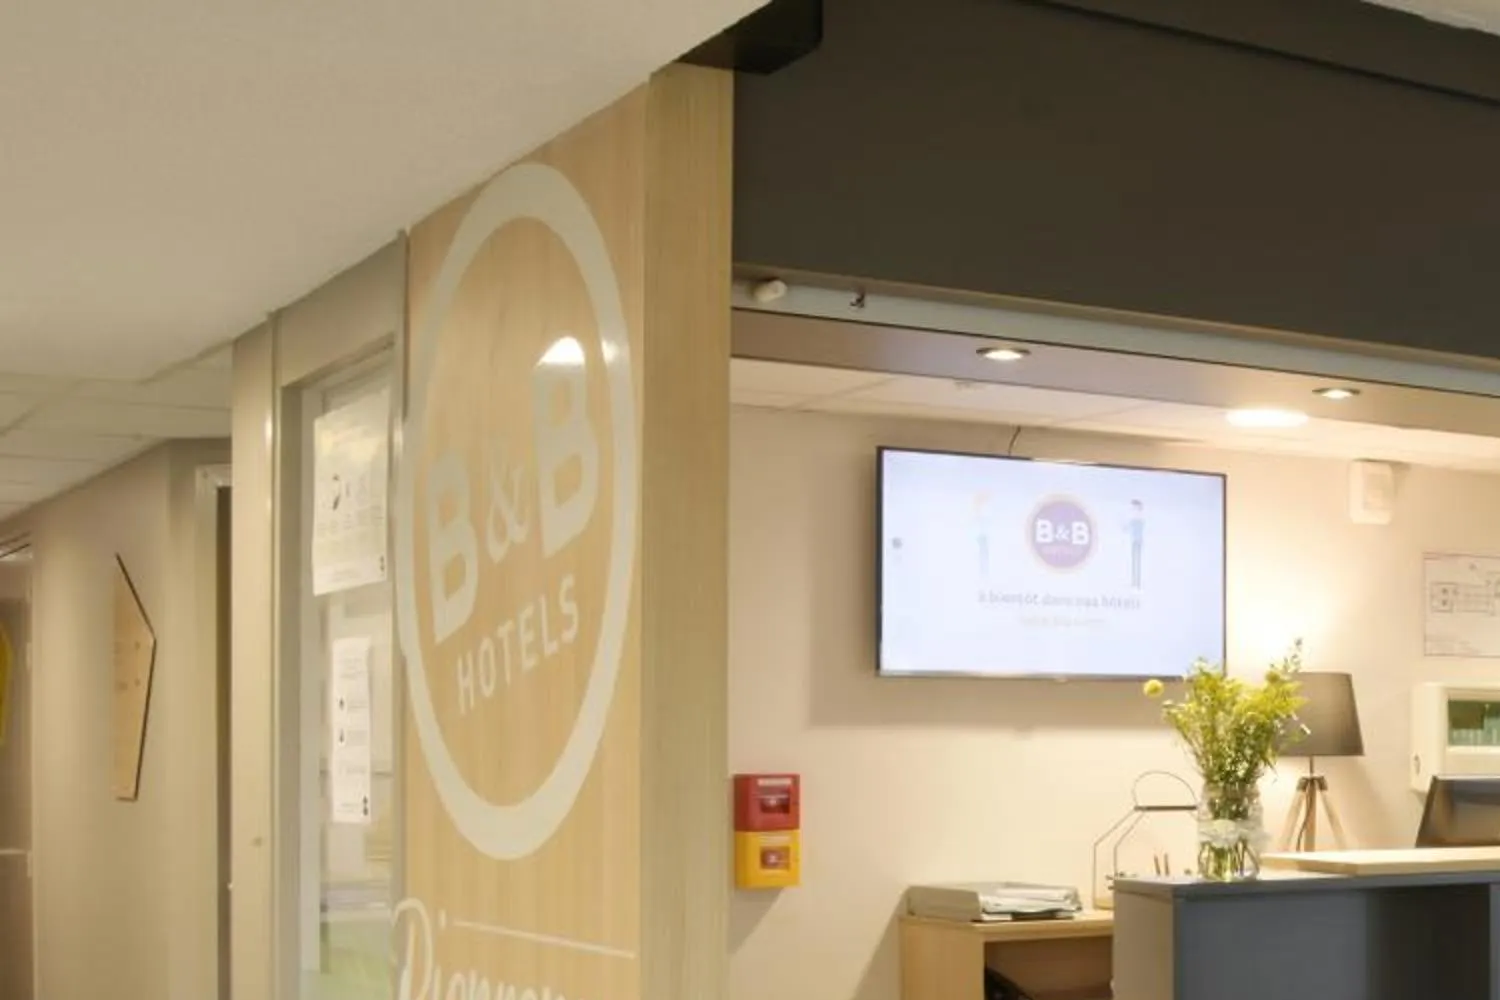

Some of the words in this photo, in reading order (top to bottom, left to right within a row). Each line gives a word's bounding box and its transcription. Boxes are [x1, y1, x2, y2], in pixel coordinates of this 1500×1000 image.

[424, 350, 601, 644] B&B
[1035, 518, 1090, 545] B&B
[456, 573, 580, 716] HOTELS
